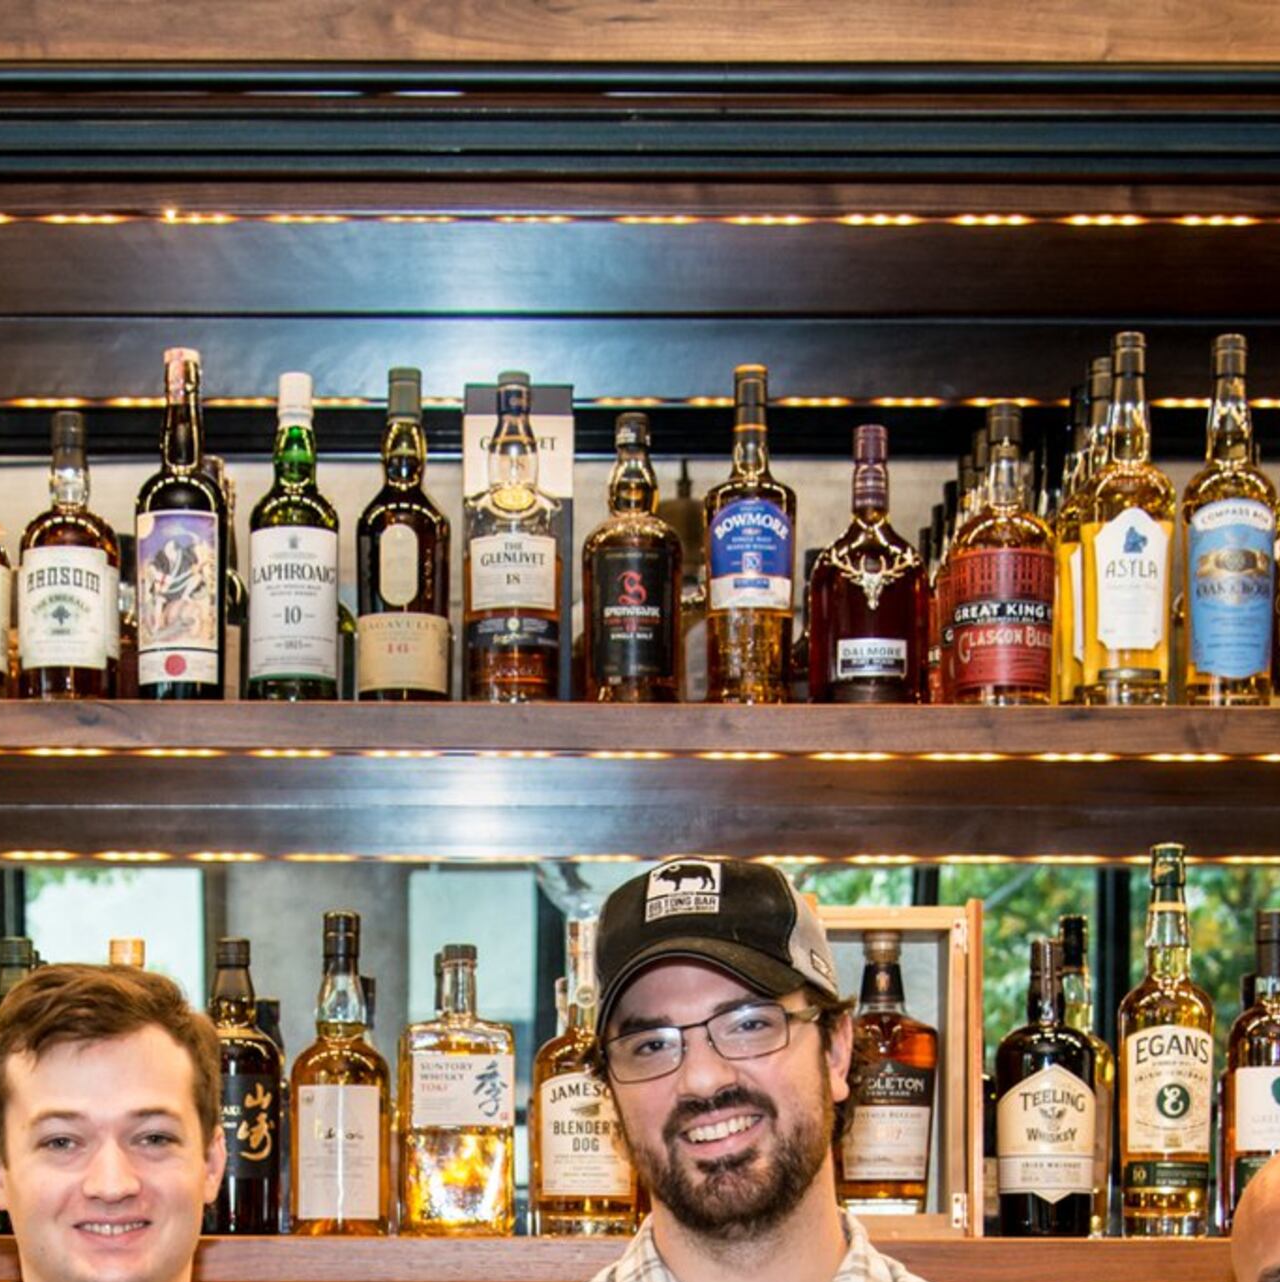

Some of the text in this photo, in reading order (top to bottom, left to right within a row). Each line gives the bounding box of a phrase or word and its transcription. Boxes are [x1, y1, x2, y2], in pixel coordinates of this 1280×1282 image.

[1201, 507, 1250, 524] COMPASS
[714, 513, 789, 540] BOWMORE
[480, 552, 545, 567] GLENLIVET
[253, 563, 336, 585] LAPHROAIG
[1106, 560, 1158, 578] ASYLA
[26, 567, 100, 594] RANSOM
[506, 574, 521, 585] 18
[284, 605, 302, 624] 10
[954, 602, 1045, 622] GREAT KING
[842, 646, 902, 658] DALMORE
[1136, 1034, 1209, 1064] EGANS
[420, 1062, 473, 1072] SUNTORY
[420, 1073, 465, 1082] WHISKY
[1019, 1090, 1085, 1112] TEELING
[1026, 1127, 1078, 1143] WHISKEY
[572, 1137, 600, 1152] DOG
